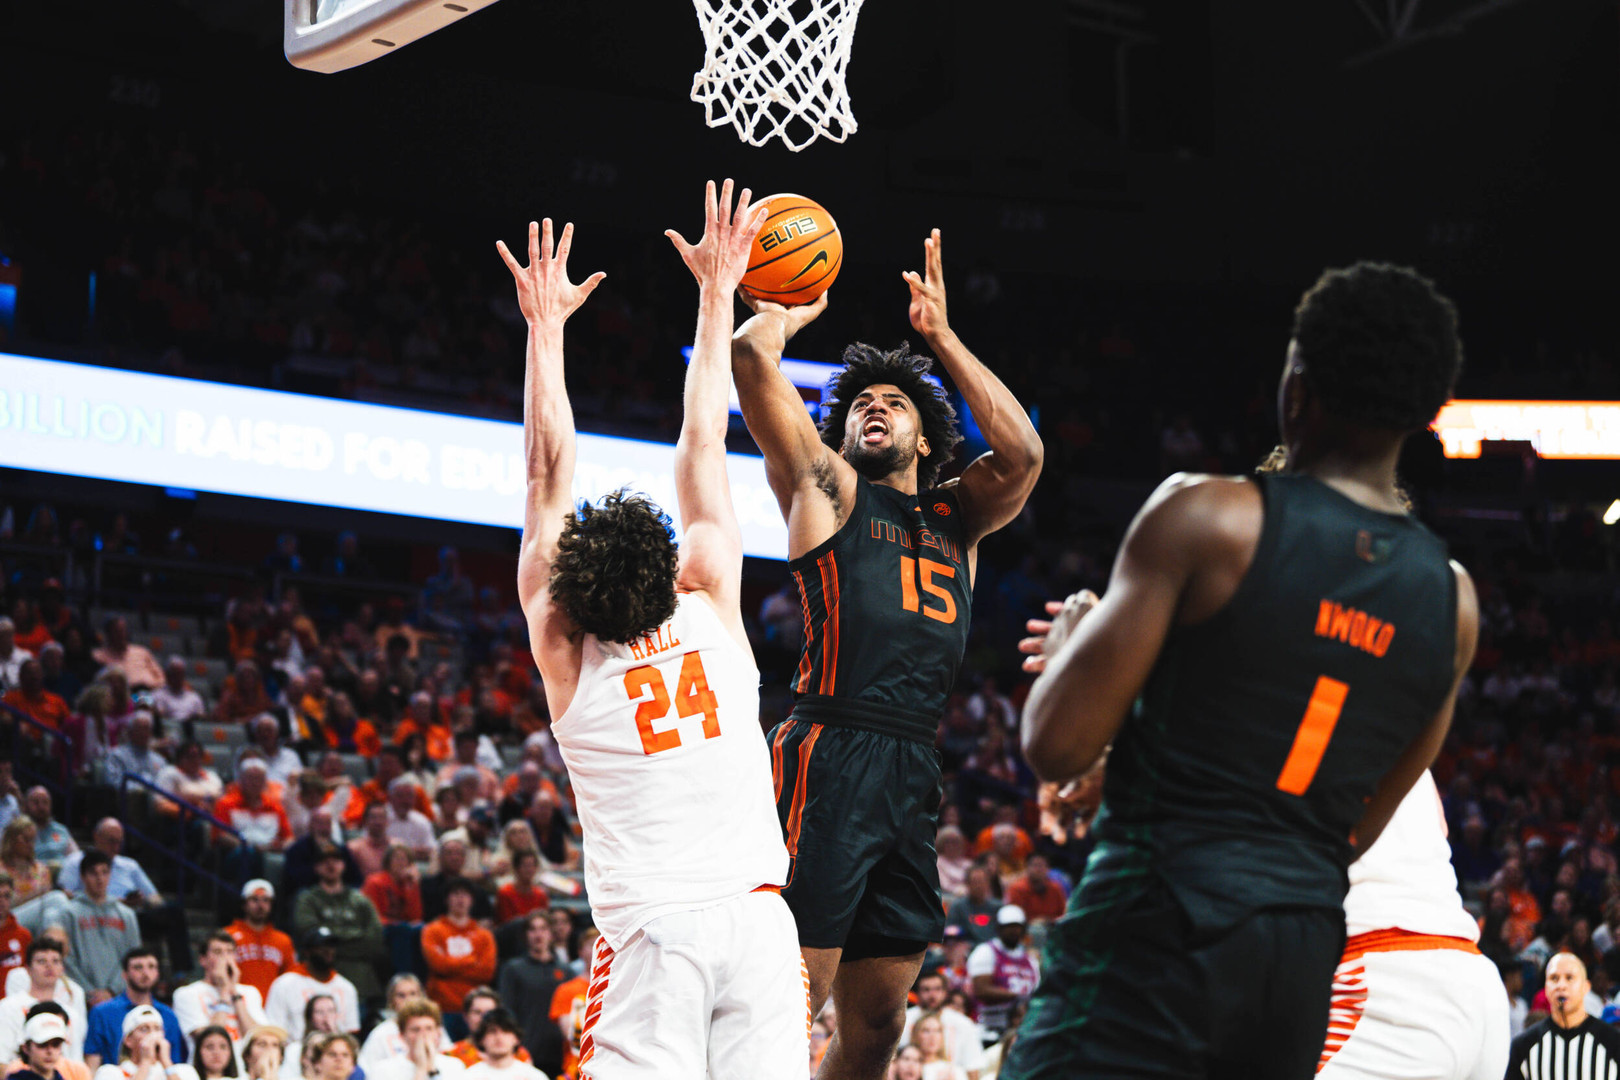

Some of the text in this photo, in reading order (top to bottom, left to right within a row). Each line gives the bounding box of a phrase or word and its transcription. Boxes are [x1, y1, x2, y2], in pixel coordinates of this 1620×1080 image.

[758, 216, 818, 253] ELITE
[174, 409, 335, 471] RAISED
[343, 432, 432, 485] FOR
[900, 555, 957, 624] 15
[627, 623, 681, 661] HALL
[1314, 599, 1395, 658] NWOKO
[623, 650, 722, 756] 24
[1276, 674, 1349, 797] 1
